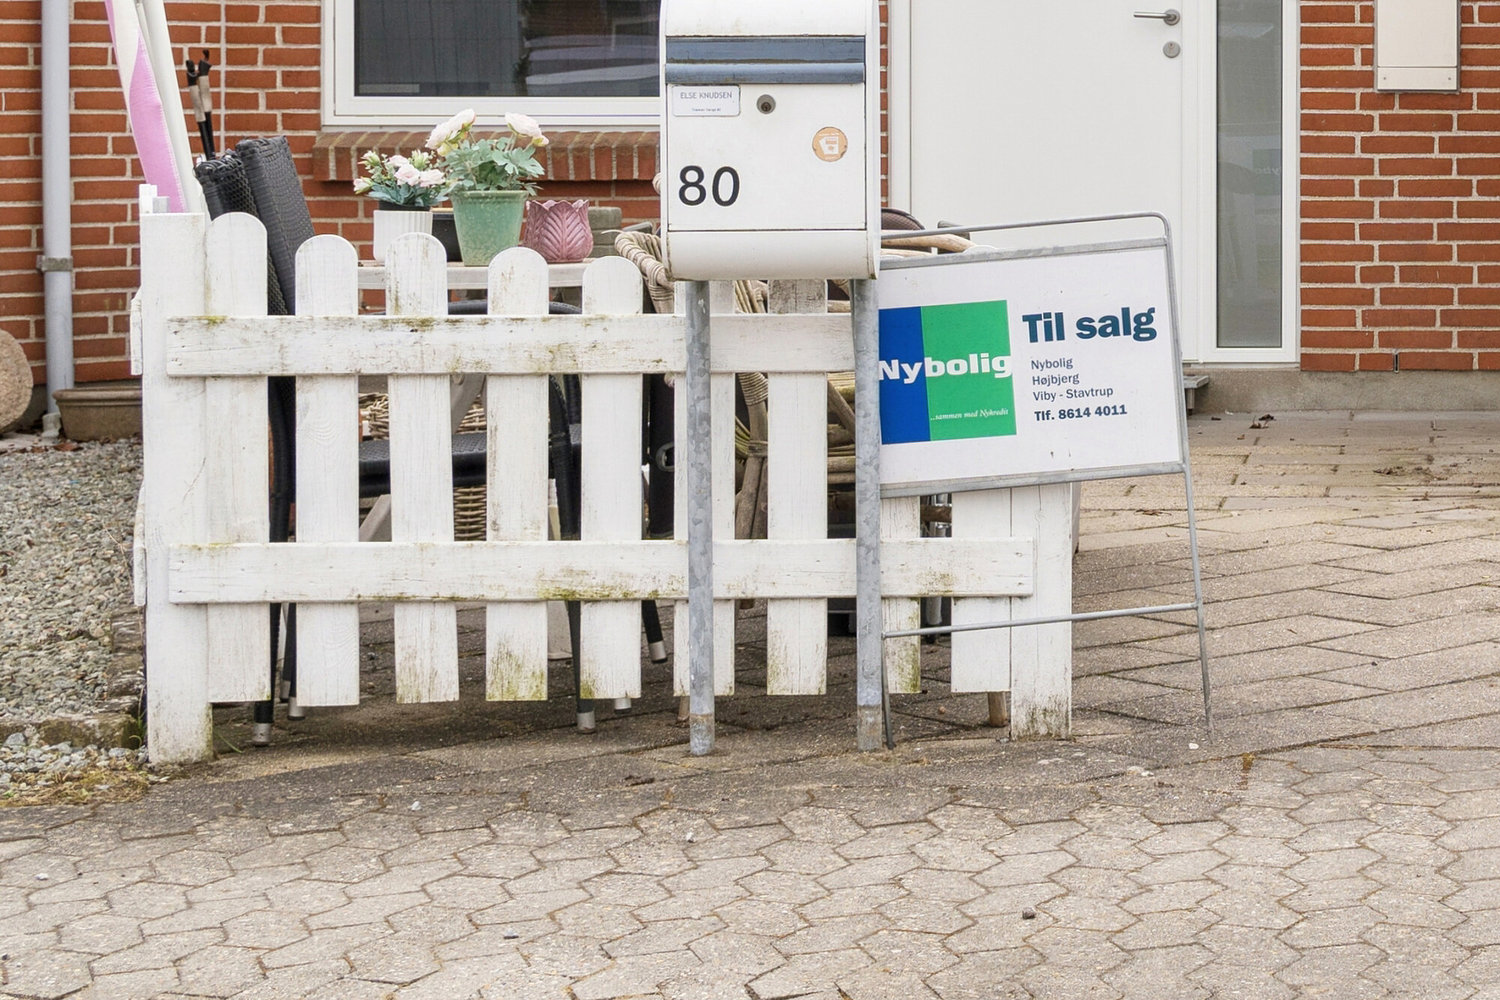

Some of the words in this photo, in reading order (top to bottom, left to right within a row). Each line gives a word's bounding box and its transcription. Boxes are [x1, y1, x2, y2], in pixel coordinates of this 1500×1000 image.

[678, 164, 740, 207] 80
[1022, 311, 1065, 343] Til
[1075, 306, 1158, 342] salg
[878, 352, 1013, 385] Nybolig
[1031, 357, 1074, 372] Nybolig
[1032, 373, 1080, 387] Højbjerg
[1033, 390, 1057, 403] Viby
[1066, 387, 1114, 400] Stavtrup
[1034, 409, 1055, 421] Tlf.
[1058, 406, 1092, 420] 8614
[1094, 404, 1128, 417] 4011
